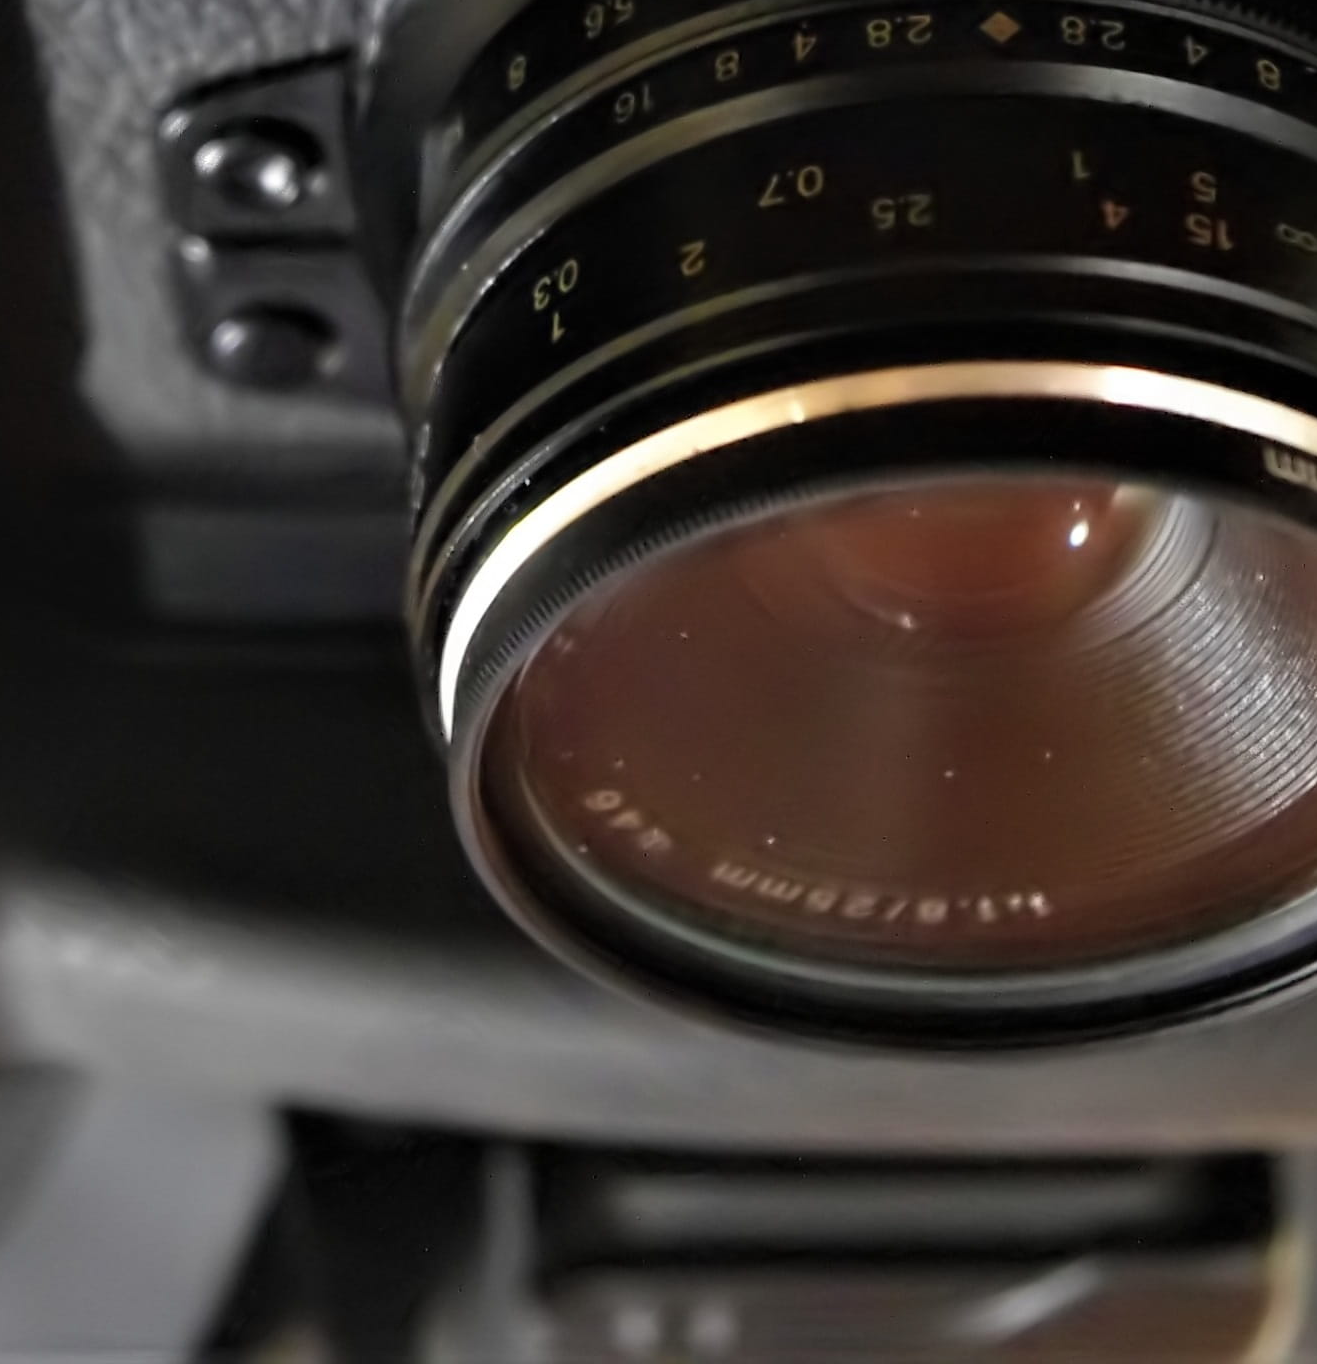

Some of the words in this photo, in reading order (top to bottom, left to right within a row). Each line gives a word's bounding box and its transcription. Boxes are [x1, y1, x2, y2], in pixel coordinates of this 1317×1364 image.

[792, 31, 818, 63] 4
[864, 12, 934, 49] 2.8
[1058, 14, 1127, 52] 2.8
[713, 48, 741, 83] 8
[1183, 35, 1210, 67] 4
[1254, 57, 1282, 92] 8
[613, 82, 656, 124] 16
[1071, 150, 1091, 181] 1
[756, 163, 825, 209] 0.7
[1189, 170, 1218, 205] 5
[869, 192, 933, 232] 2.5
[1101, 199, 1129, 230] 4
[1184, 212, 1235, 252] 15
[679, 239, 706, 278] 2
[531, 257, 580, 312] 0.3
[550, 310, 566, 343] 1
